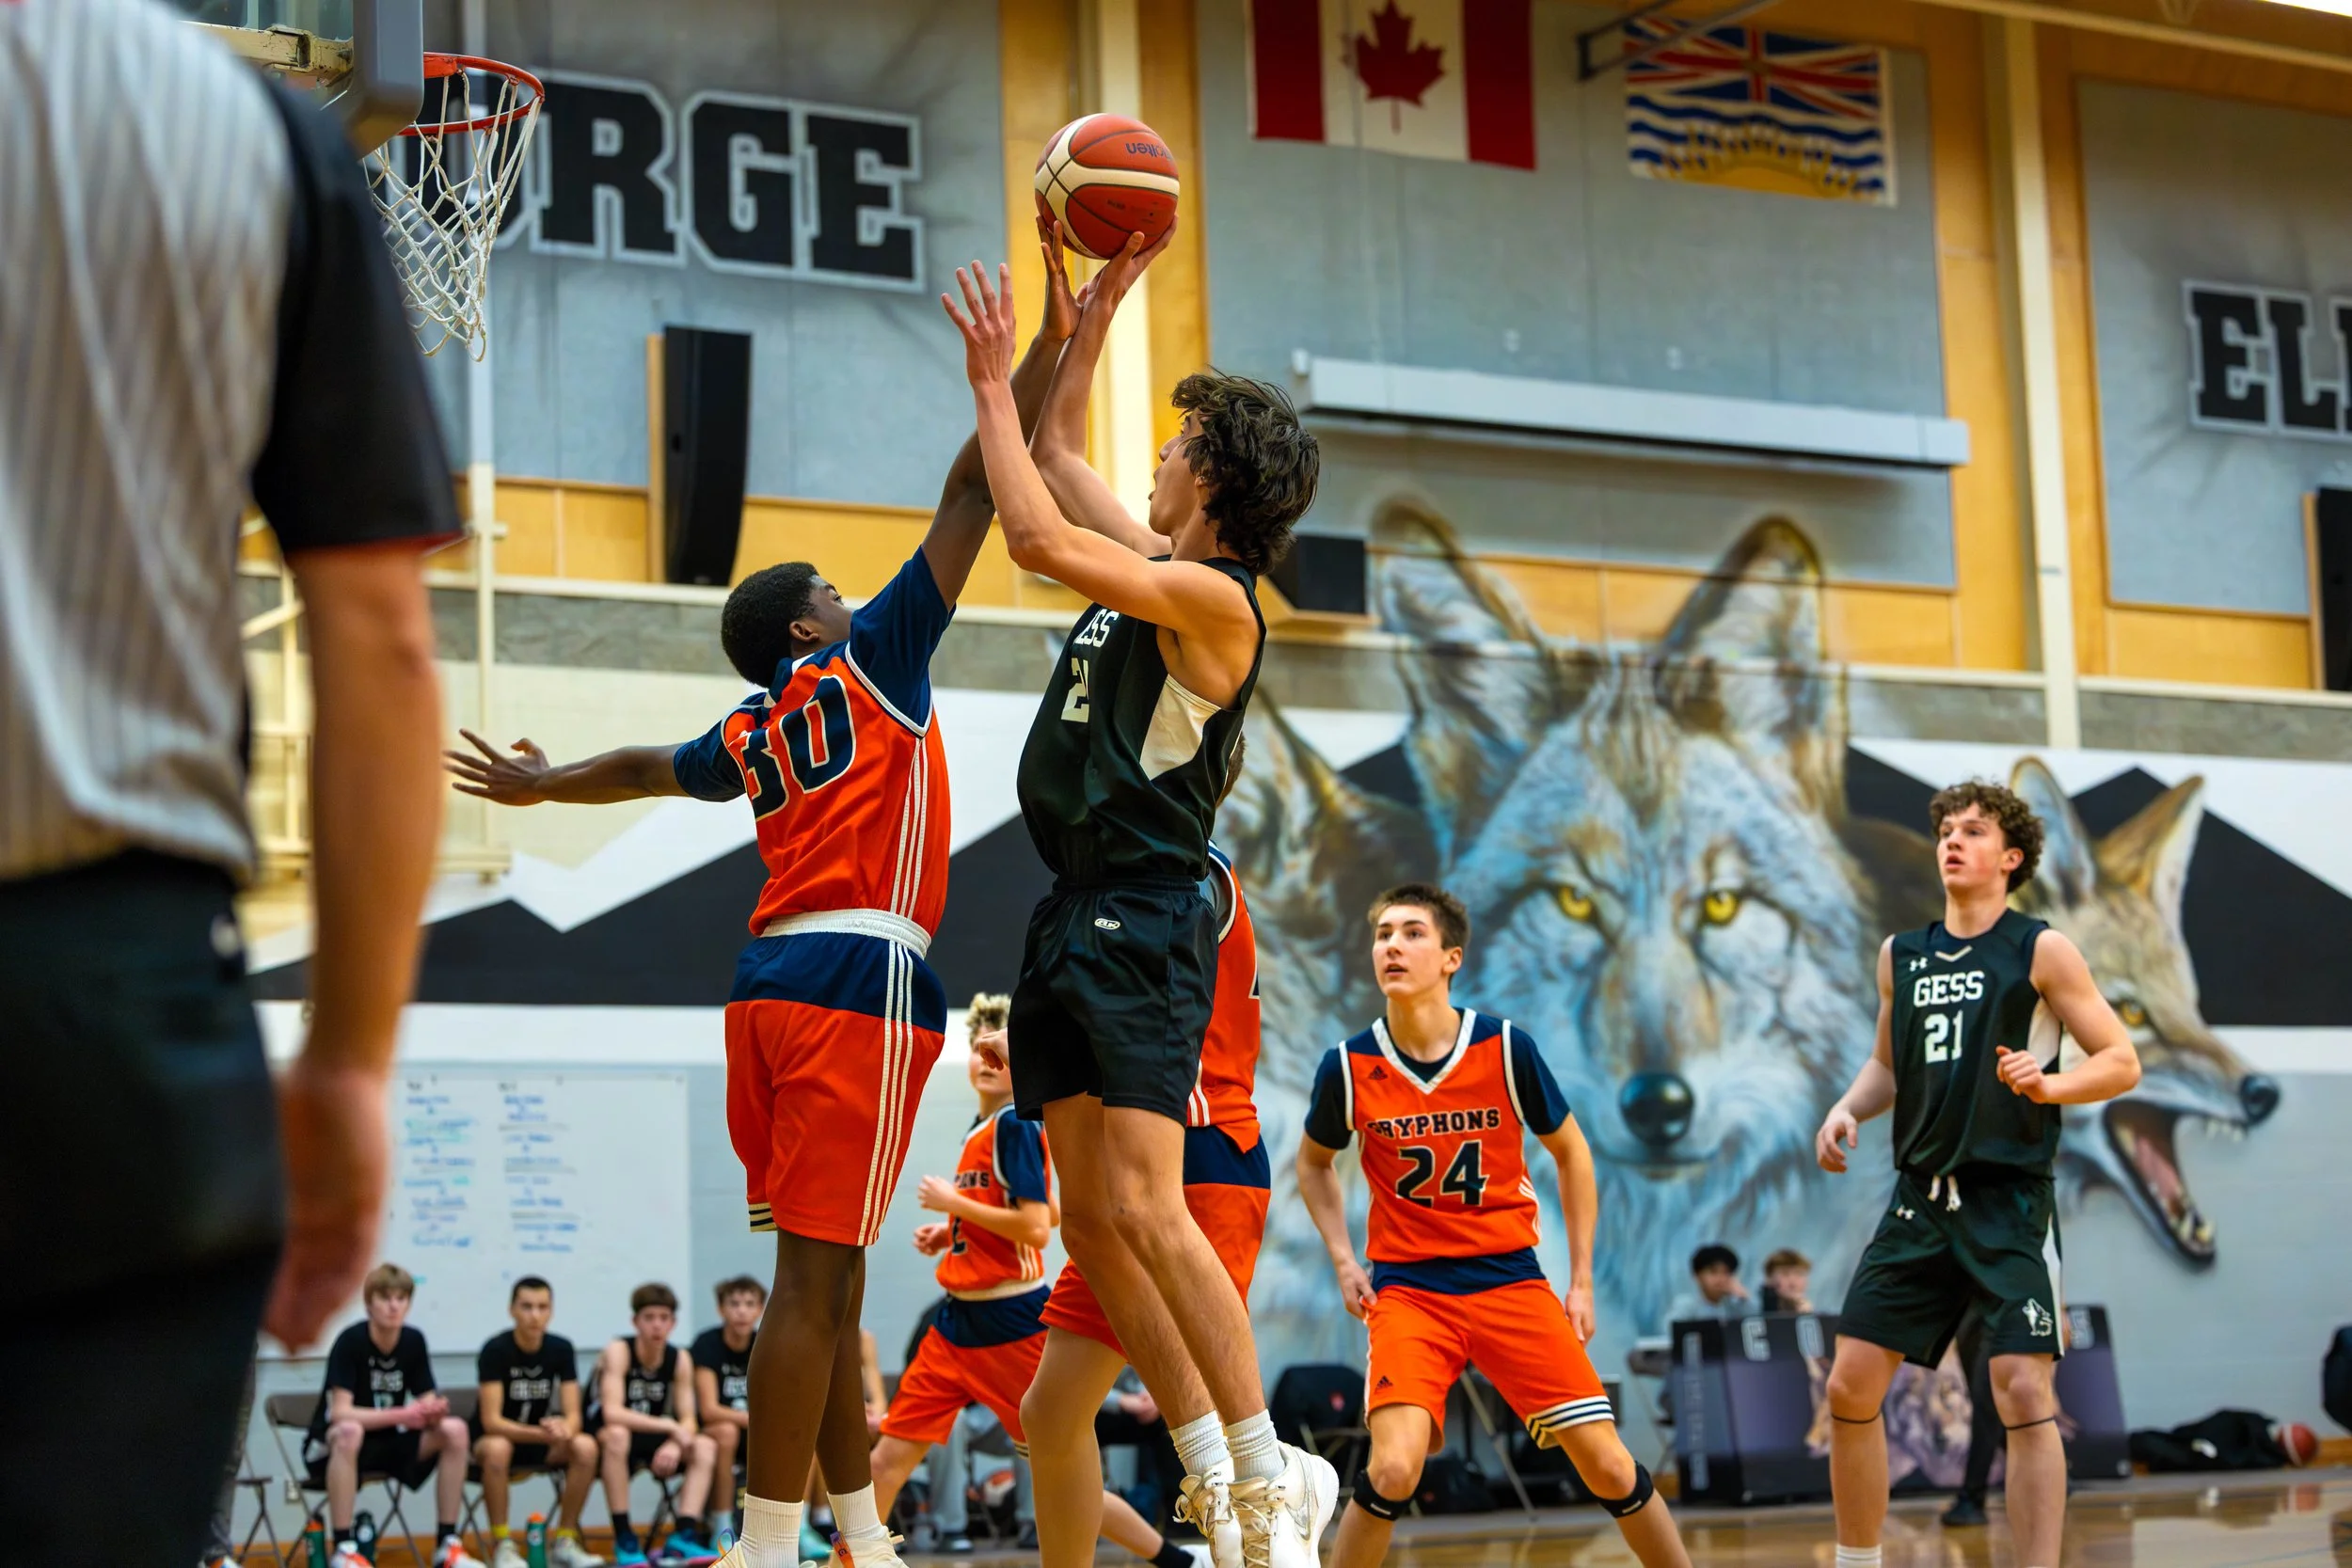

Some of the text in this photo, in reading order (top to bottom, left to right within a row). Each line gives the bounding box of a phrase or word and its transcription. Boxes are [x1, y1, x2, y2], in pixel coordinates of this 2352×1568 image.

[1913, 970, 1986, 1008] GESS
[1924, 1009, 1964, 1065] 21
[1395, 1139, 1490, 1209] 24
